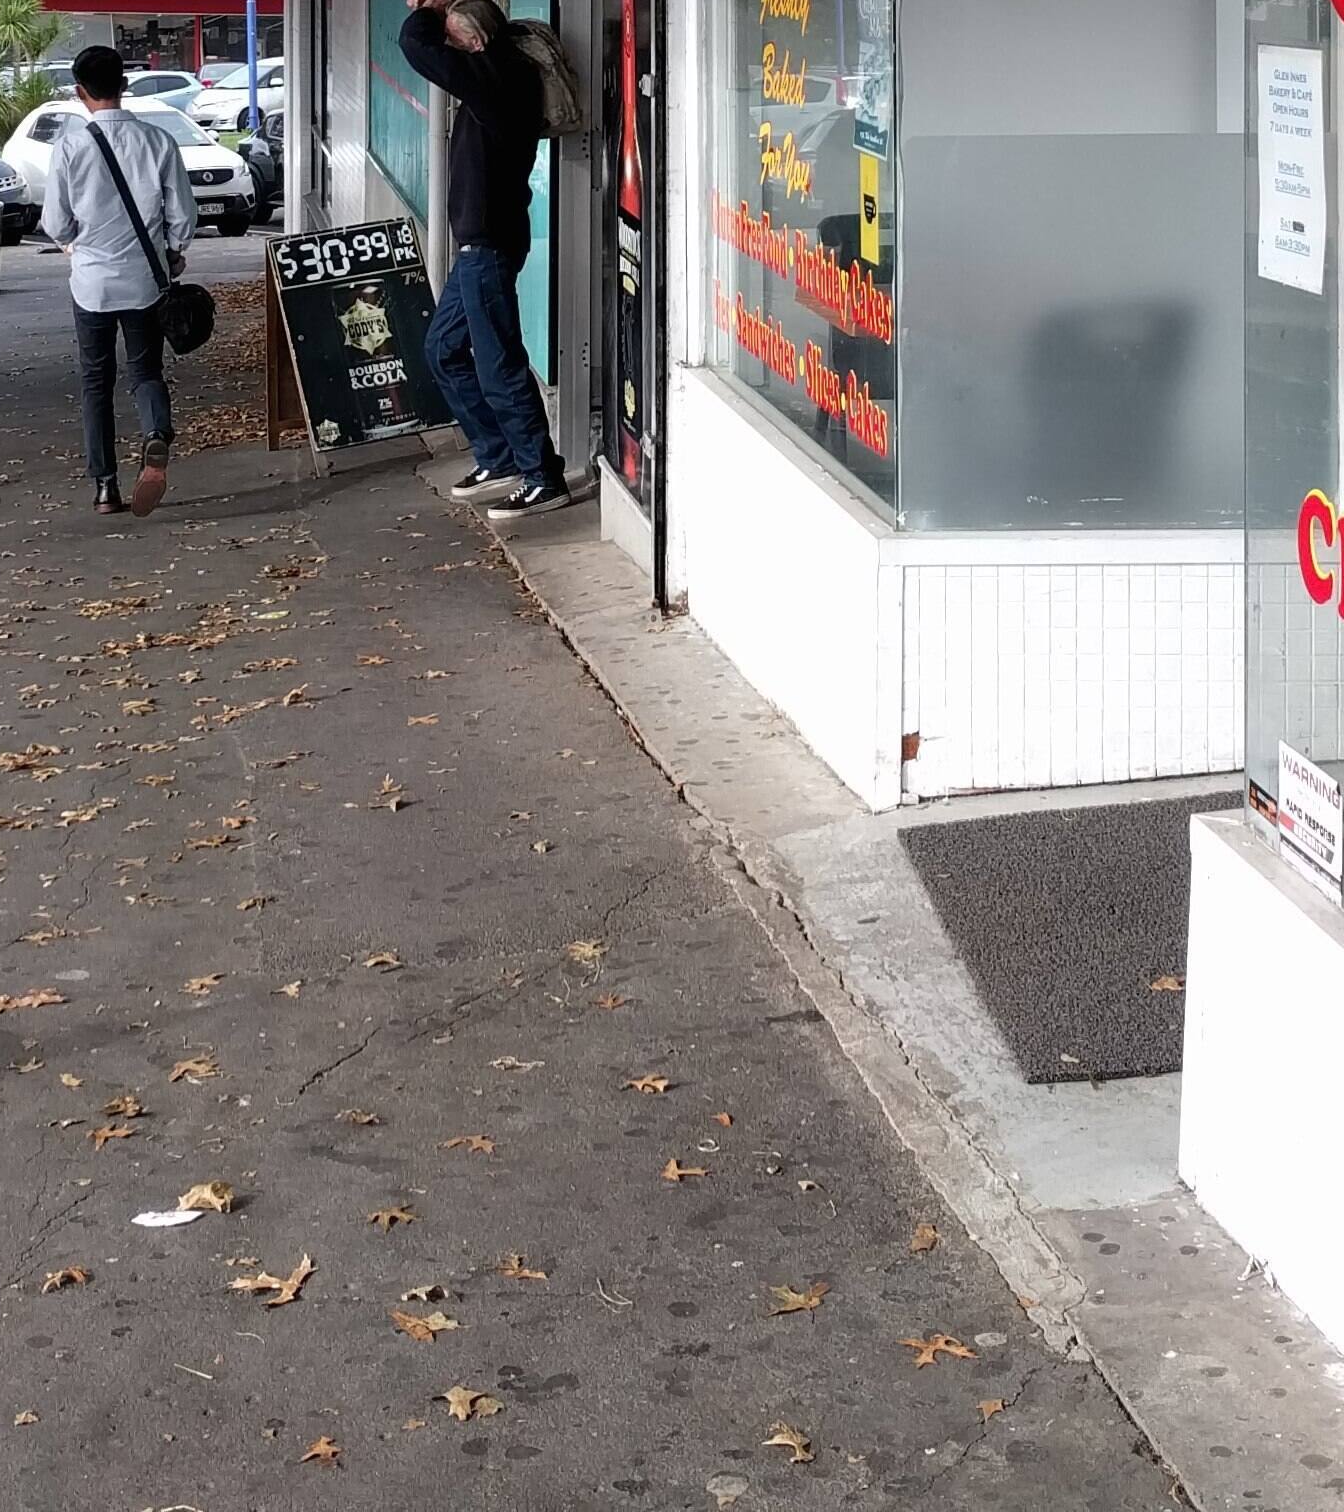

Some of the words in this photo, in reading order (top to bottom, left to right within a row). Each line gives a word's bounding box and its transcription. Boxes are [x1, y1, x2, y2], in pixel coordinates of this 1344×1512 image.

[761, 41, 807, 109] Baked
[758, 121, 783, 186] For
[276, 232, 391, 281] $30.99
[395, 245, 418, 262] PK
[401, 269, 426, 287] 7%
[794, 228, 849, 329] Birthday
[849, 259, 892, 345] Cakes
[348, 358, 405, 379] BOURBON
[736, 290, 796, 386] Sandwiches
[805, 339, 841, 420] Slices
[846, 368, 888, 458] Cakes
[1281, 750, 1341, 810] WARNING
